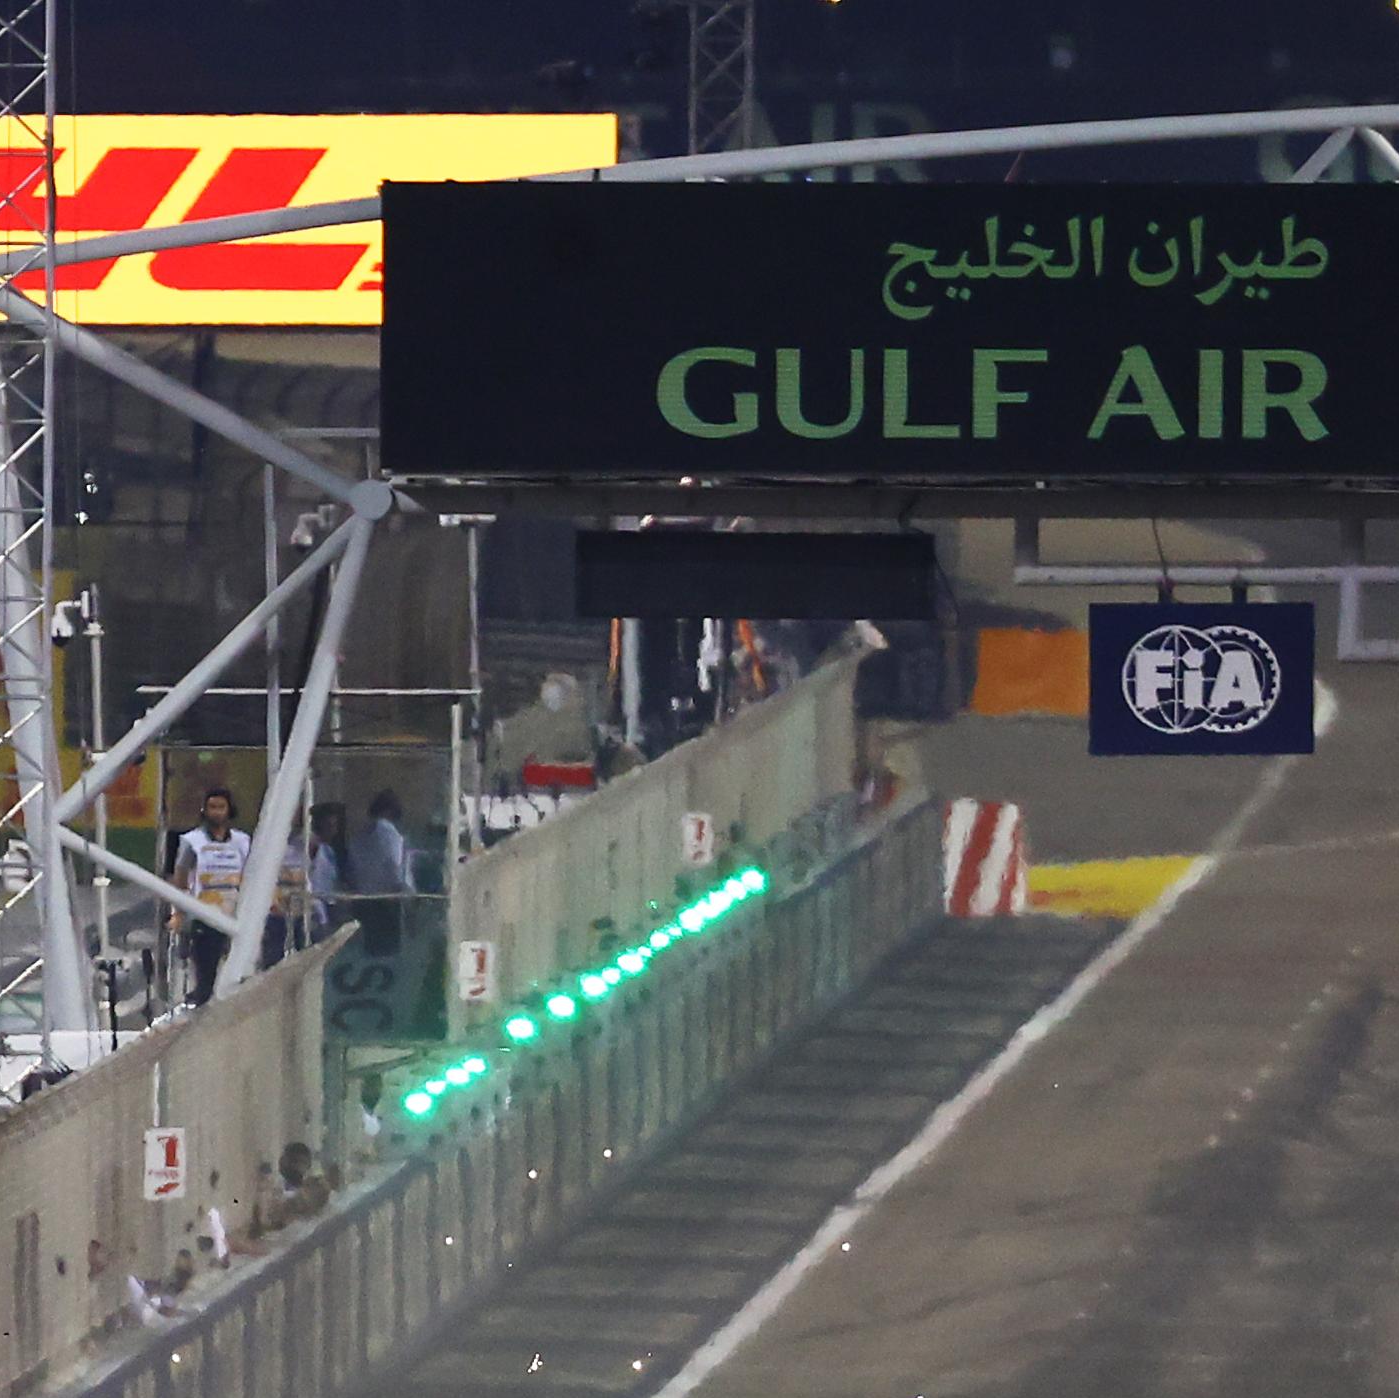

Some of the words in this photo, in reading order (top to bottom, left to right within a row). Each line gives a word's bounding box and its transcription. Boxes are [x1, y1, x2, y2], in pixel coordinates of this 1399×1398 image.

[882, 215, 1105, 320] الخليج
[1128, 216, 1329, 305] طيران
[657, 347, 1048, 440] GULF
[1088, 345, 1329, 441] AIR
